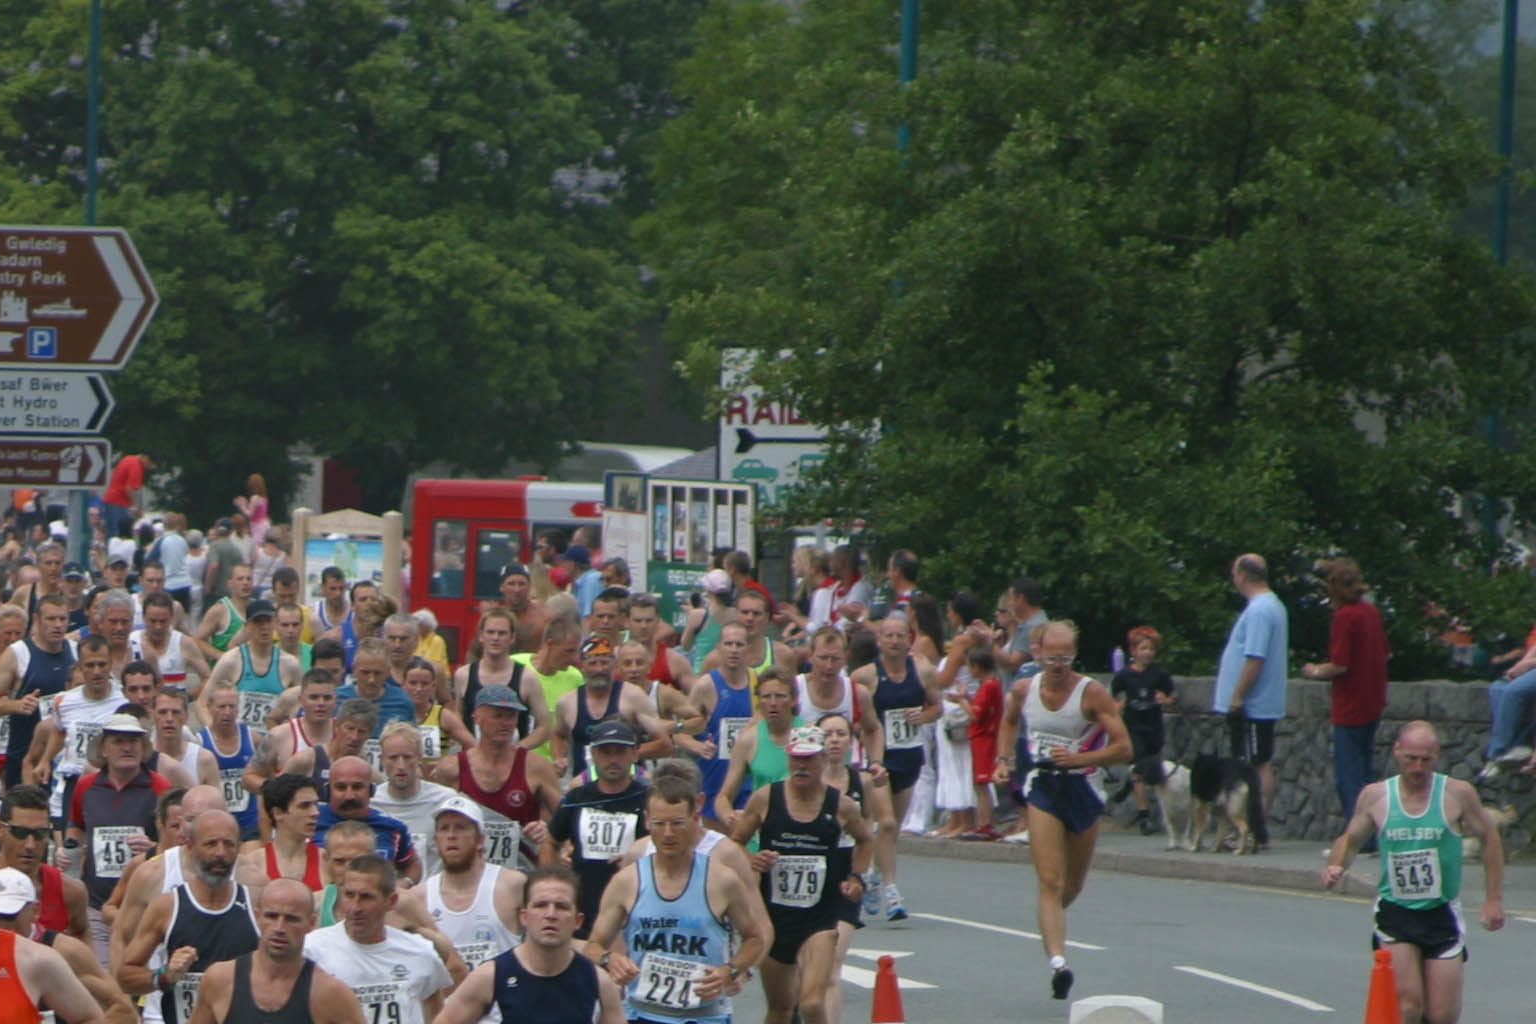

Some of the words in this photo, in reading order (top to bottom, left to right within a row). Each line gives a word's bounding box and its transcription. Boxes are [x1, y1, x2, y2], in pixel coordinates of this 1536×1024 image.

[31, 271, 66, 285] Park
[13, 395, 58, 411] Hydro
[726, 392, 808, 425] RAIL
[24, 414, 81, 428] Station
[224, 781, 244, 801] 60
[588, 821, 627, 847] 307
[1386, 827, 1444, 840] HELSBY
[104, 841, 126, 864] 45
[489, 836, 512, 859] 78
[778, 870, 818, 894] 379
[1394, 864, 1435, 888] 543
[646, 972, 693, 1008] 224
